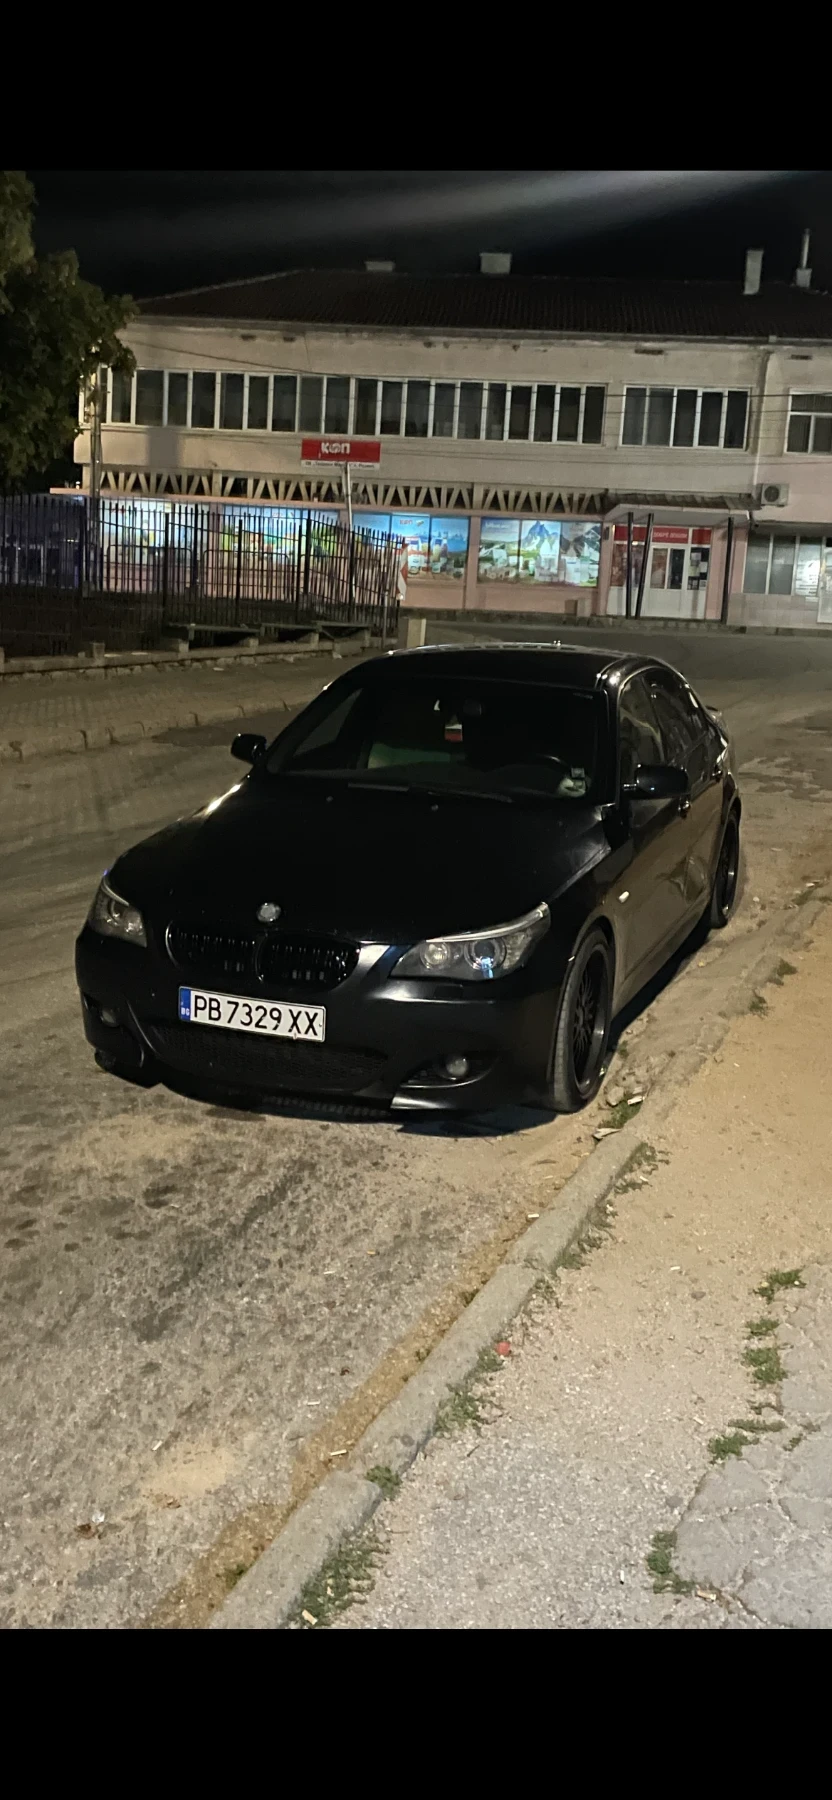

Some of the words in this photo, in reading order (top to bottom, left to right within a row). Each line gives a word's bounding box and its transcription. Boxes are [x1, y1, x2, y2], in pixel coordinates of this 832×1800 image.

[321, 442, 351, 455] КОП
[194, 994, 222, 1022] PB
[226, 1000, 282, 1031] 7329
[287, 1008, 319, 1036] XX
